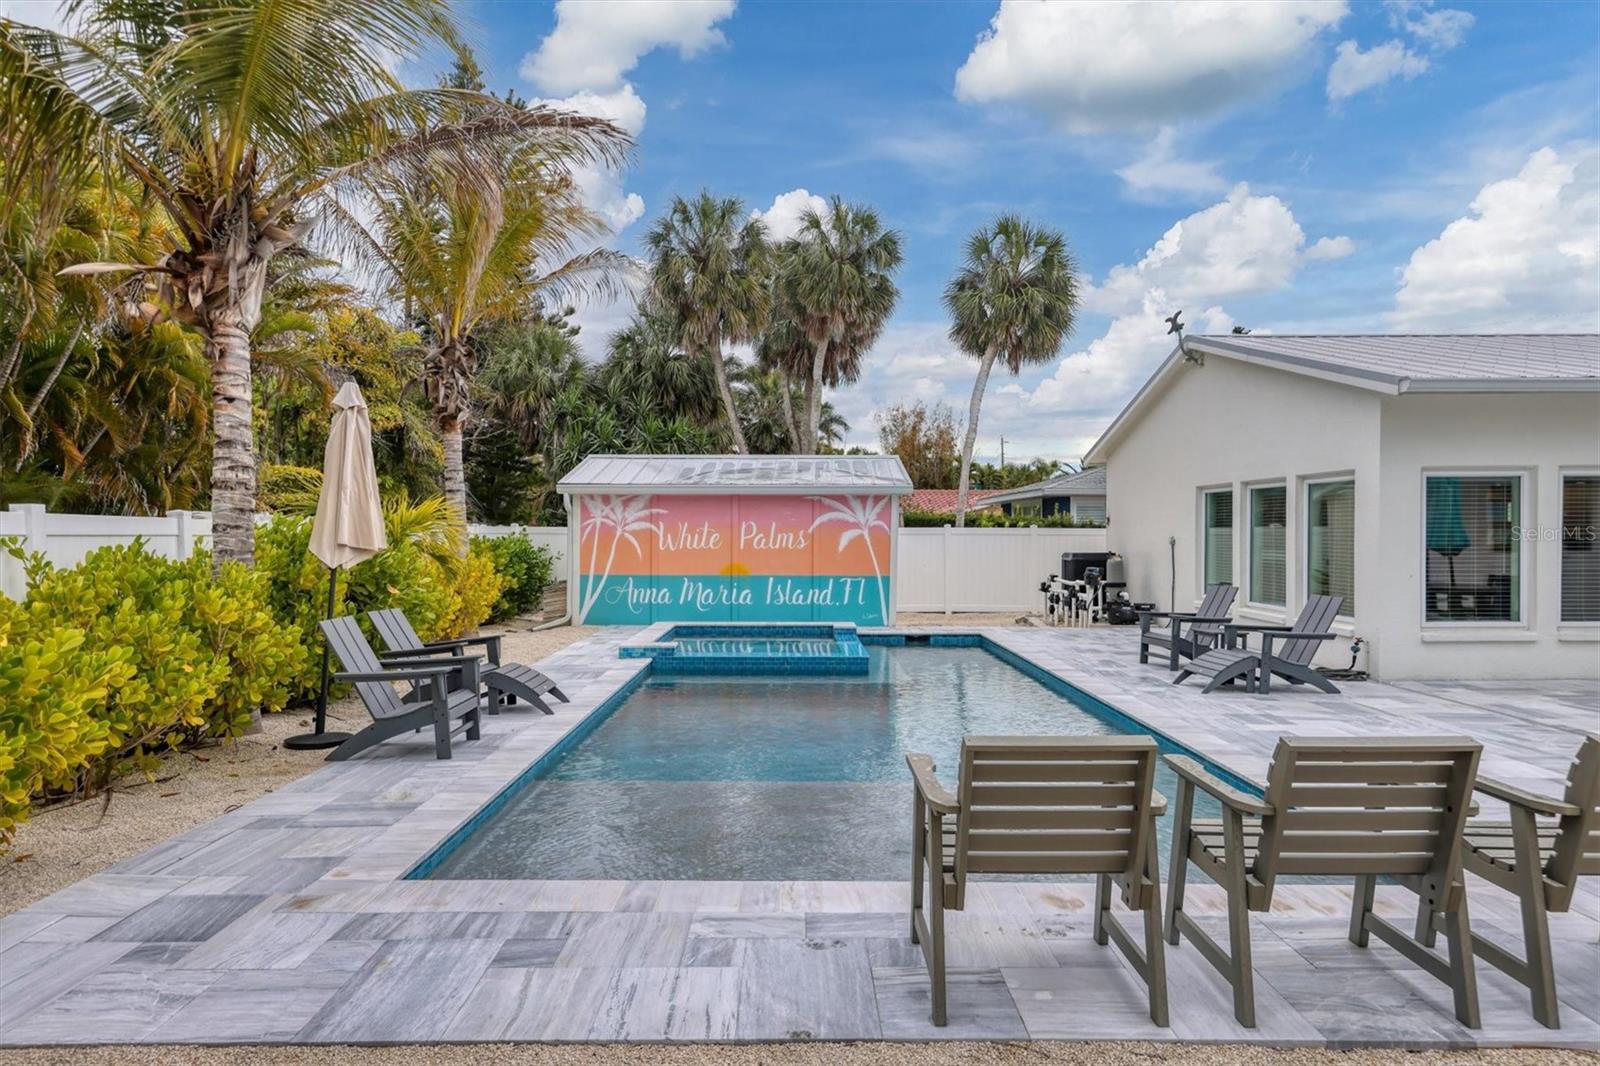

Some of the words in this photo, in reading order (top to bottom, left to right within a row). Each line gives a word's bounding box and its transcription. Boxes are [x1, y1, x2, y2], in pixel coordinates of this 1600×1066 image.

[658, 521, 722, 551] White
[740, 521, 809, 549] Palms
[605, 576, 672, 614] Anna
[679, 577, 753, 612] Maria
